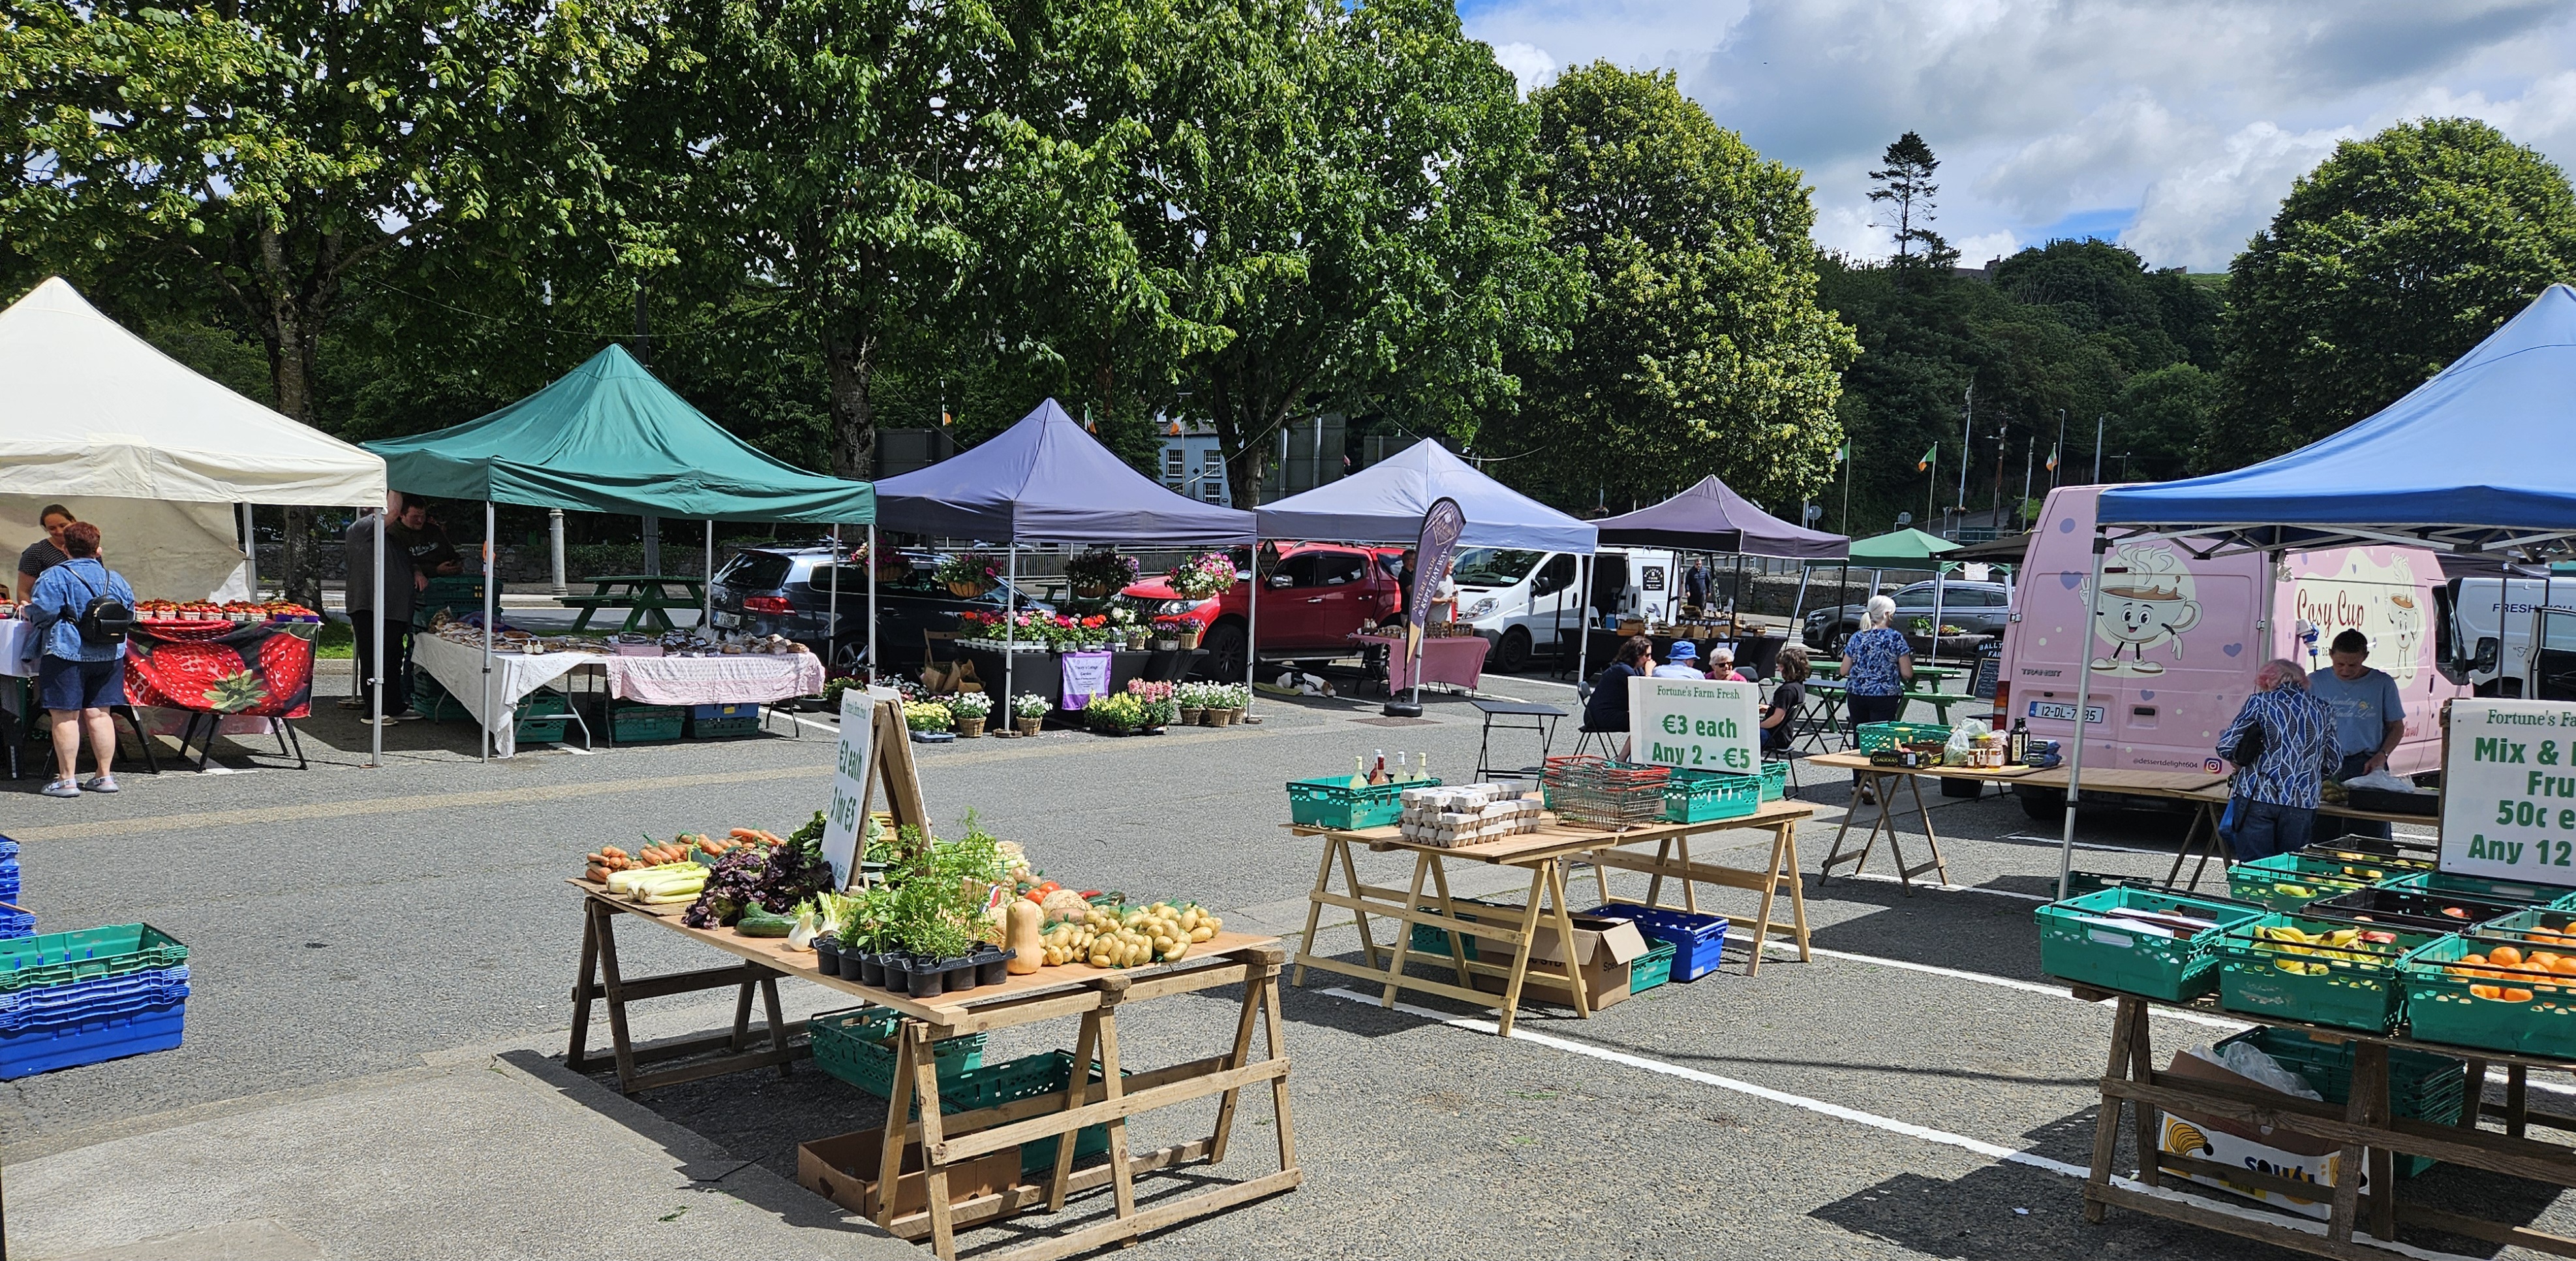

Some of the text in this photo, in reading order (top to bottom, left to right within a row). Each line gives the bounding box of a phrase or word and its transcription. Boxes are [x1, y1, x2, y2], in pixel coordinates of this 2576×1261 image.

[1413, 555, 1437, 612] NATURE MADE
[1420, 589, 1430, 609] KEPT
[1428, 565, 1438, 590] THAT
[1437, 548, 1448, 567] WAY
[2297, 589, 2363, 638] Cosy Cup
[2492, 604, 2536, 613] FRESH
[2021, 668, 2062, 677] TRANSIT
[1657, 685, 1740, 699] Fortune's Farm Fresh
[1662, 714, 1737, 738] €3 each
[2041, 706, 2096, 721] 12-DL-75
[2487, 709, 2556, 726] Fortune's
[839, 739, 862, 783] €2 each
[1652, 742, 1685, 766] Any
[1692, 745, 1702, 765] 2
[1723, 747, 1751, 769] €5
[2133, 758, 2198, 768] @dessertdelight604
[2475, 737, 2526, 764] Mix
[2537, 739, 2559, 766] &
[2527, 770, 2575, 798] Fru
[836, 788, 846, 826] for
[844, 796, 856, 833] €5
[2496, 800, 2547, 828] 50c
[2468, 834, 2572, 867] Any 12
